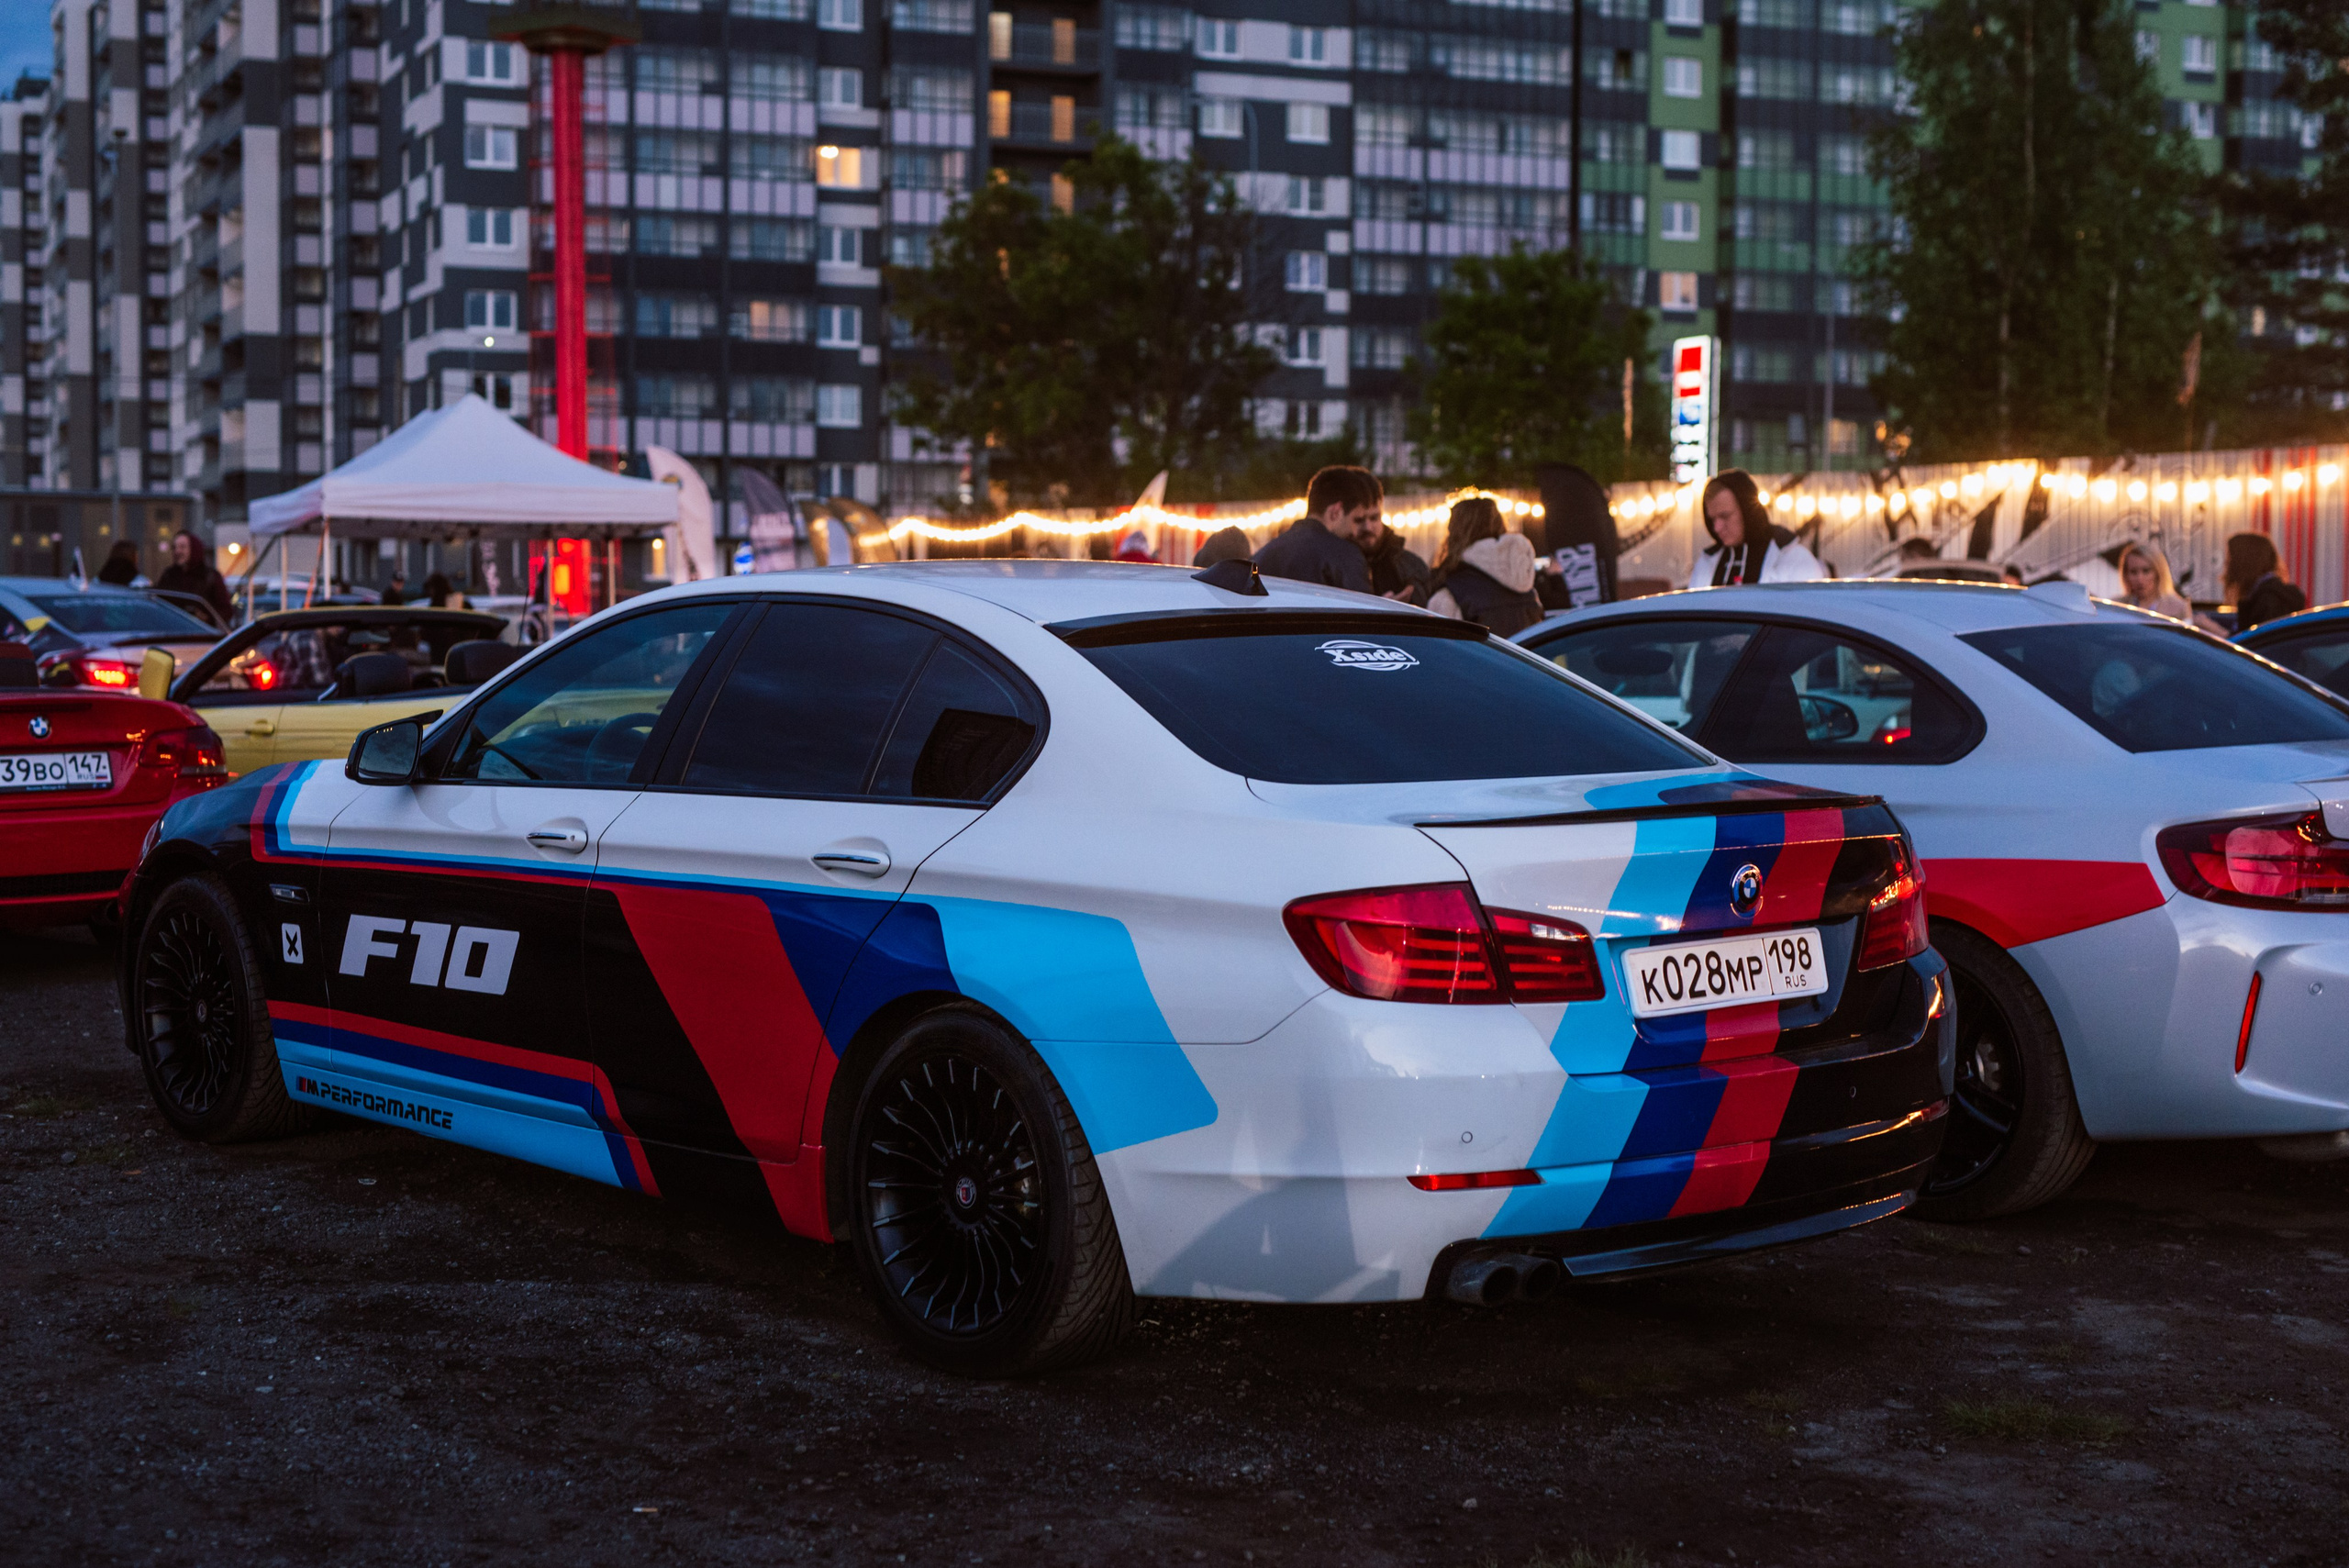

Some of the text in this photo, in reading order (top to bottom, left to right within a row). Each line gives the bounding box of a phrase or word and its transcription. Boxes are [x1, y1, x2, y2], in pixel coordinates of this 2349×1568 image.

[69, 755, 101, 773] 147
[339, 914, 520, 995] F10
[1641, 937, 1812, 1005] K028MP 198
[1785, 974, 1807, 989] RUS
[320, 1082, 453, 1130] PERFORMANCE
